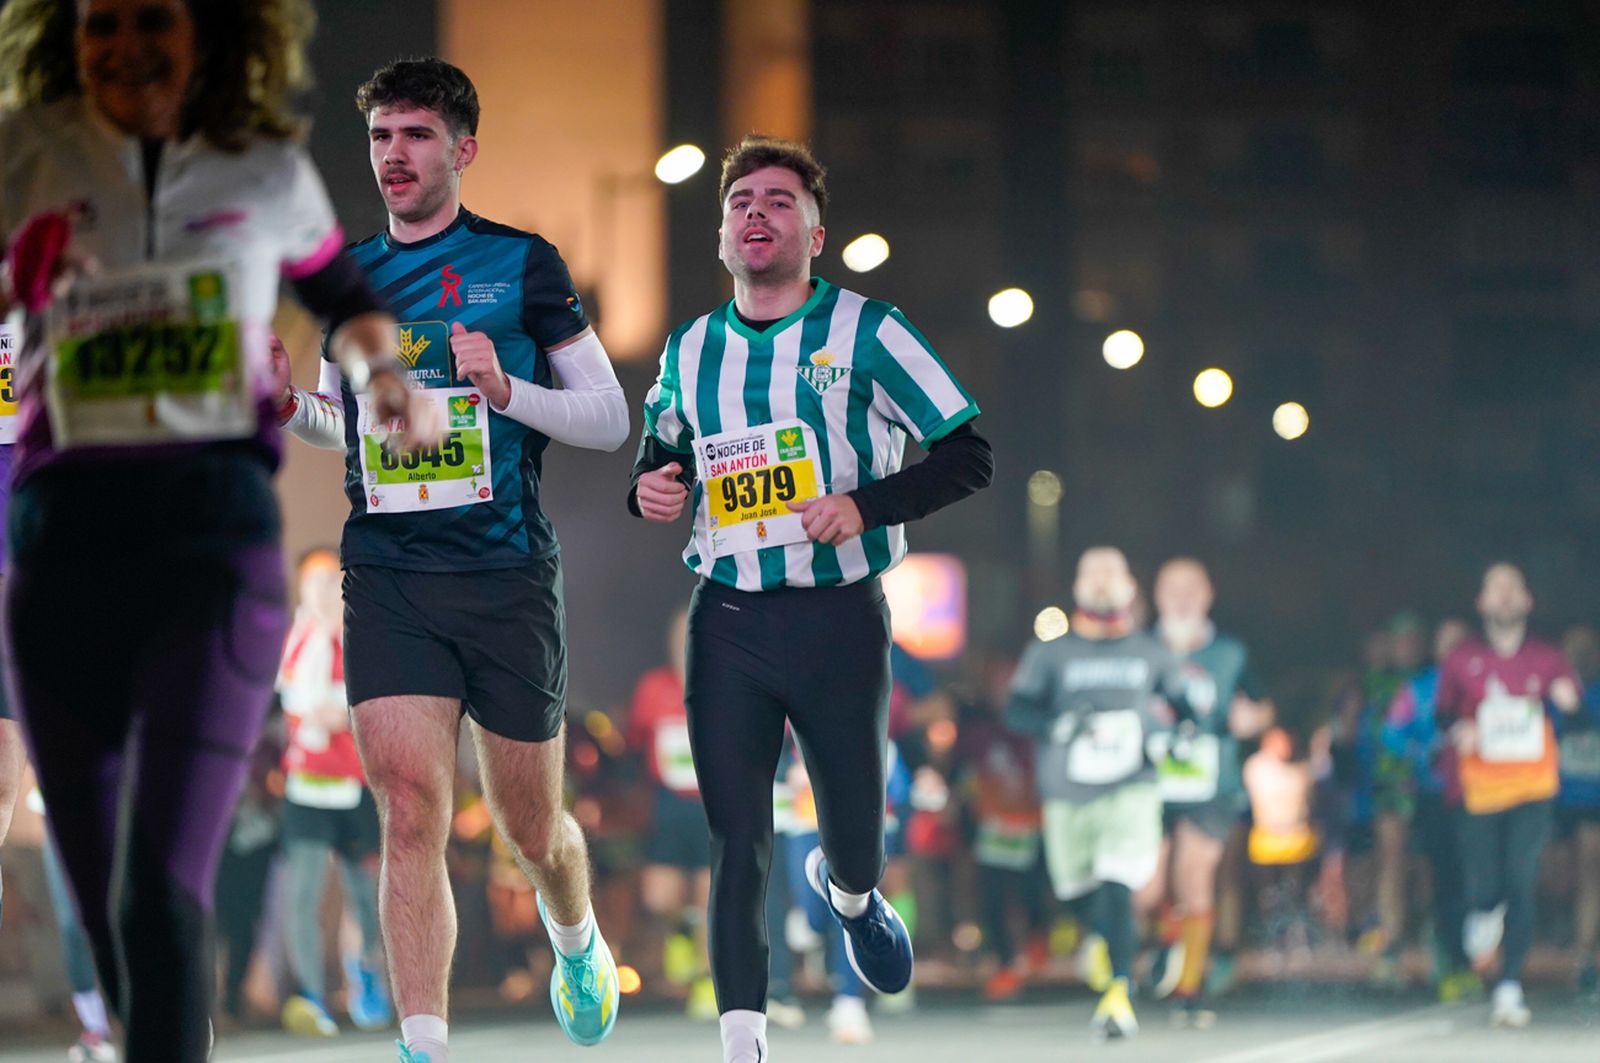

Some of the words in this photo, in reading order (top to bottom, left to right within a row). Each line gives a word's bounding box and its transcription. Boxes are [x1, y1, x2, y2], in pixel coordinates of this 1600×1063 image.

[408, 369, 445, 379] RURAL
[717, 441, 750, 459] NOCHE
[752, 439, 766, 451] DE
[710, 460, 728, 477] SAN
[730, 452, 767, 472] ANTÓN
[408, 471, 437, 481] Alberto
[721, 465, 796, 512] 9379
[740, 510, 758, 521] Juan
[760, 507, 777, 518] José
